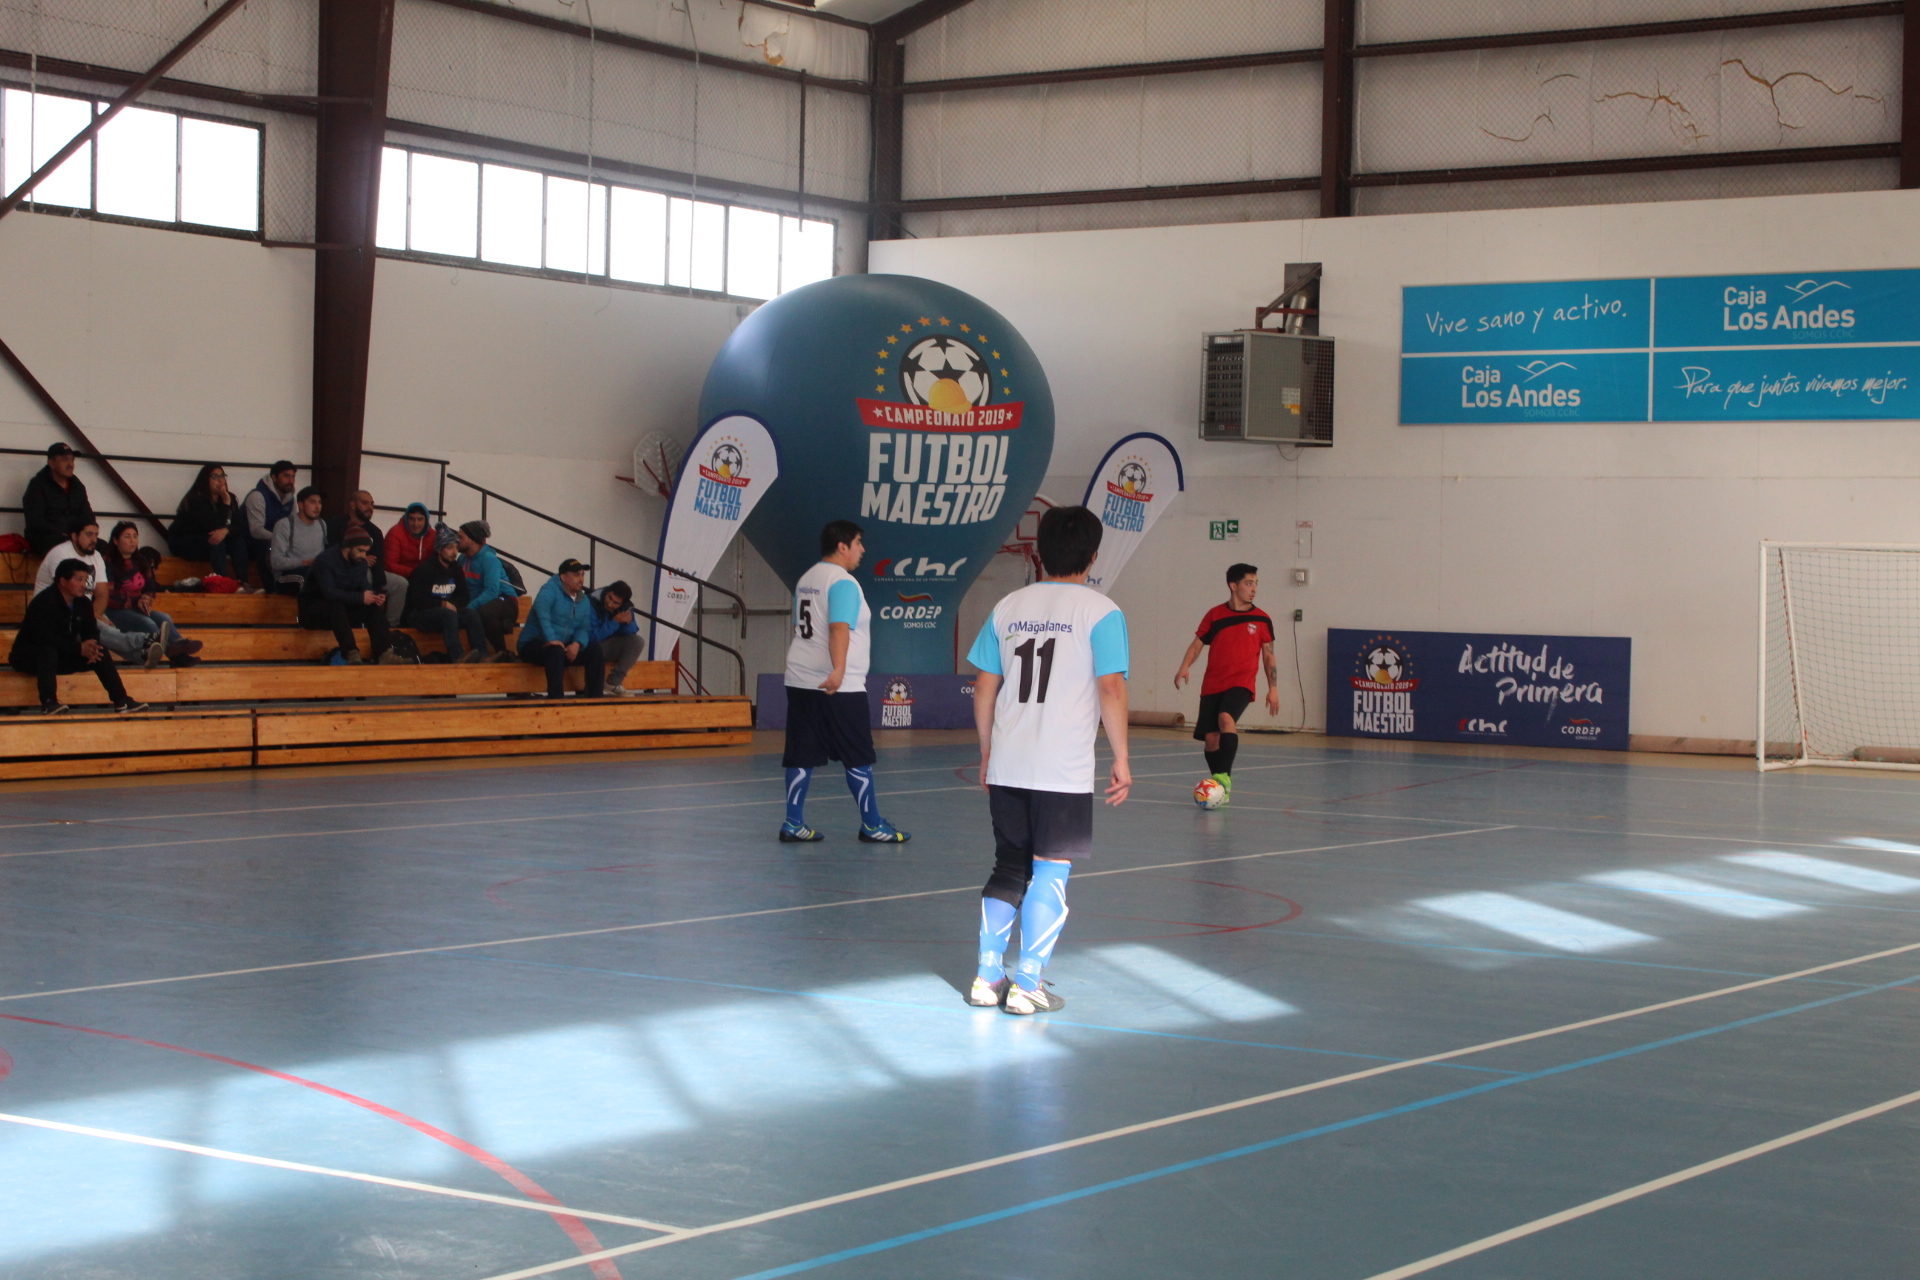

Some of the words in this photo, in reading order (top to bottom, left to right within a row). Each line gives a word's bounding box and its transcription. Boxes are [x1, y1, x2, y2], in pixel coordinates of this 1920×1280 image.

[1724, 286, 1767, 309] Caja
[1425, 311, 1468, 336] Vive
[1477, 311, 1525, 332] sano
[1533, 307, 1544, 334] y
[1553, 293, 1628, 320] activo.
[1723, 307, 1768, 331] Los
[1772, 304, 1856, 330] Andes
[1462, 365, 1501, 387] Caja
[1673, 366, 1722, 399] Para
[1723, 380, 1755, 410] que
[1748, 372, 1800, 407] juntos
[1805, 374, 1858, 397] vivamos
[1861, 370, 1907, 404] mejor.
[1462, 385, 1502, 408] Los
[1505, 384, 1581, 408] Andes
[884, 406, 975, 427] CAMPEONATO
[978, 409, 1005, 426] 2019
[868, 432, 1009, 484] FUTBOL
[697, 478, 742, 506] FUTBOL
[860, 482, 1006, 525] MAESTRO
[694, 495, 741, 521] MAESTRO
[1104, 493, 1145, 519] FUTBOL
[1101, 510, 1145, 532] MAESTRO
[799, 599, 813, 639] 5
[880, 606, 942, 619] CORDEP
[1014, 638, 1056, 703] 11
[1458, 642, 1548, 675] Actitud
[1549, 656, 1575, 679] de
[1353, 690, 1414, 714] FUTBOL
[1496, 672, 1603, 712] Primera
[882, 716, 912, 726] MAESTRO
[883, 705, 912, 717] FUTBOL
[1353, 711, 1414, 733] MAESTRO
[1561, 726, 1601, 735] CORDEP
